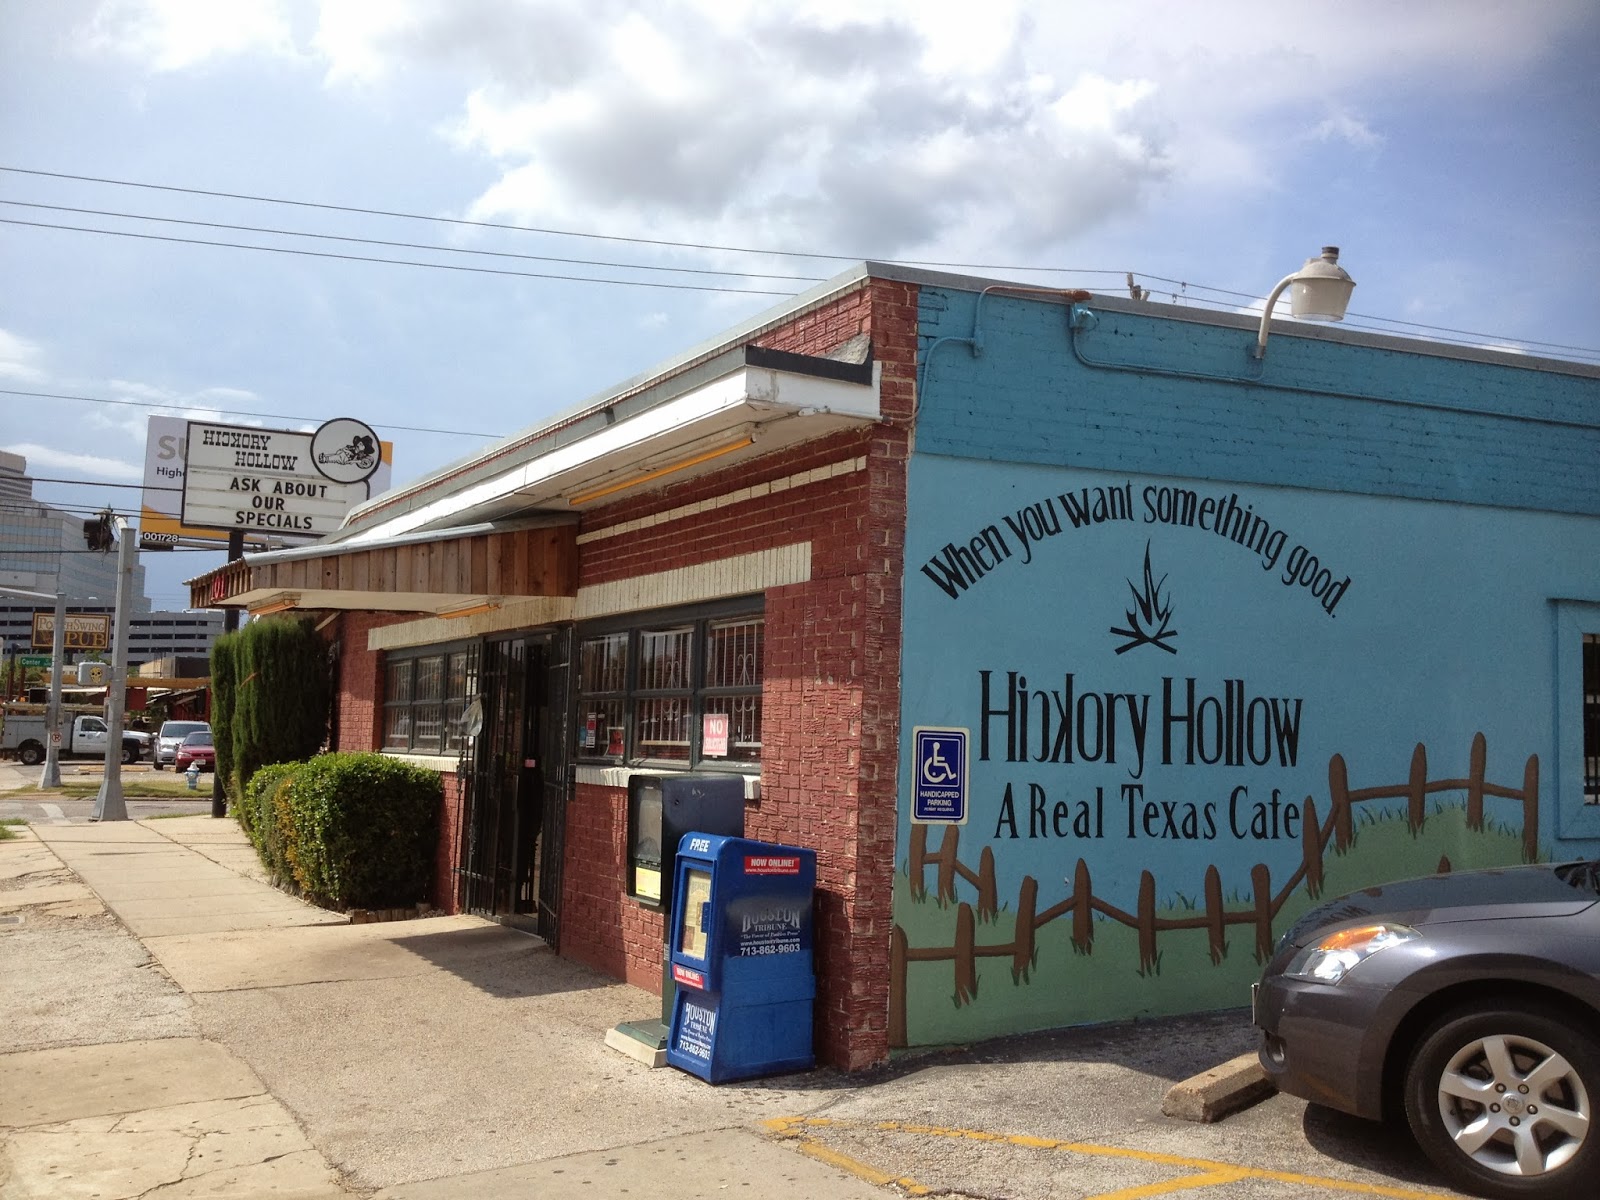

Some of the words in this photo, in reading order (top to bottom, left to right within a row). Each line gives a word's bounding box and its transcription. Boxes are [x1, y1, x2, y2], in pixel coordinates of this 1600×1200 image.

[235, 451, 298, 471] HOLLOW
[156, 466, 185, 479] High
[230, 477, 261, 492] ASK
[273, 481, 328, 498] ABOUT
[252, 496, 285, 511] OUR
[236, 511, 313, 529] SPECIALS
[143, 531, 179, 542] 001728
[920, 523, 1013, 600] When
[1002, 497, 1063, 565] you
[1057, 480, 1135, 530] want
[1143, 484, 1289, 571] something
[65, 632, 105, 646] PUB
[21, 658, 41, 666] Center
[710, 719, 723, 735] NO
[978, 670, 1152, 779] Hickory
[1161, 676, 1304, 767] Hollow
[927, 799, 952, 807] PARKING
[993, 782, 1020, 839] A
[1028, 783, 1104, 839] Real
[1121, 784, 1218, 840] Texas
[1229, 785, 1301, 839] Cafe
[690, 838, 711, 852] FREE
[751, 858, 768, 867] NOW
[768, 858, 795, 868] ONLINE!
[754, 923, 788, 932] TRIBUNE
[740, 943, 800, 956] 713-862-9603
[684, 1002, 716, 1036] HOUSTON
